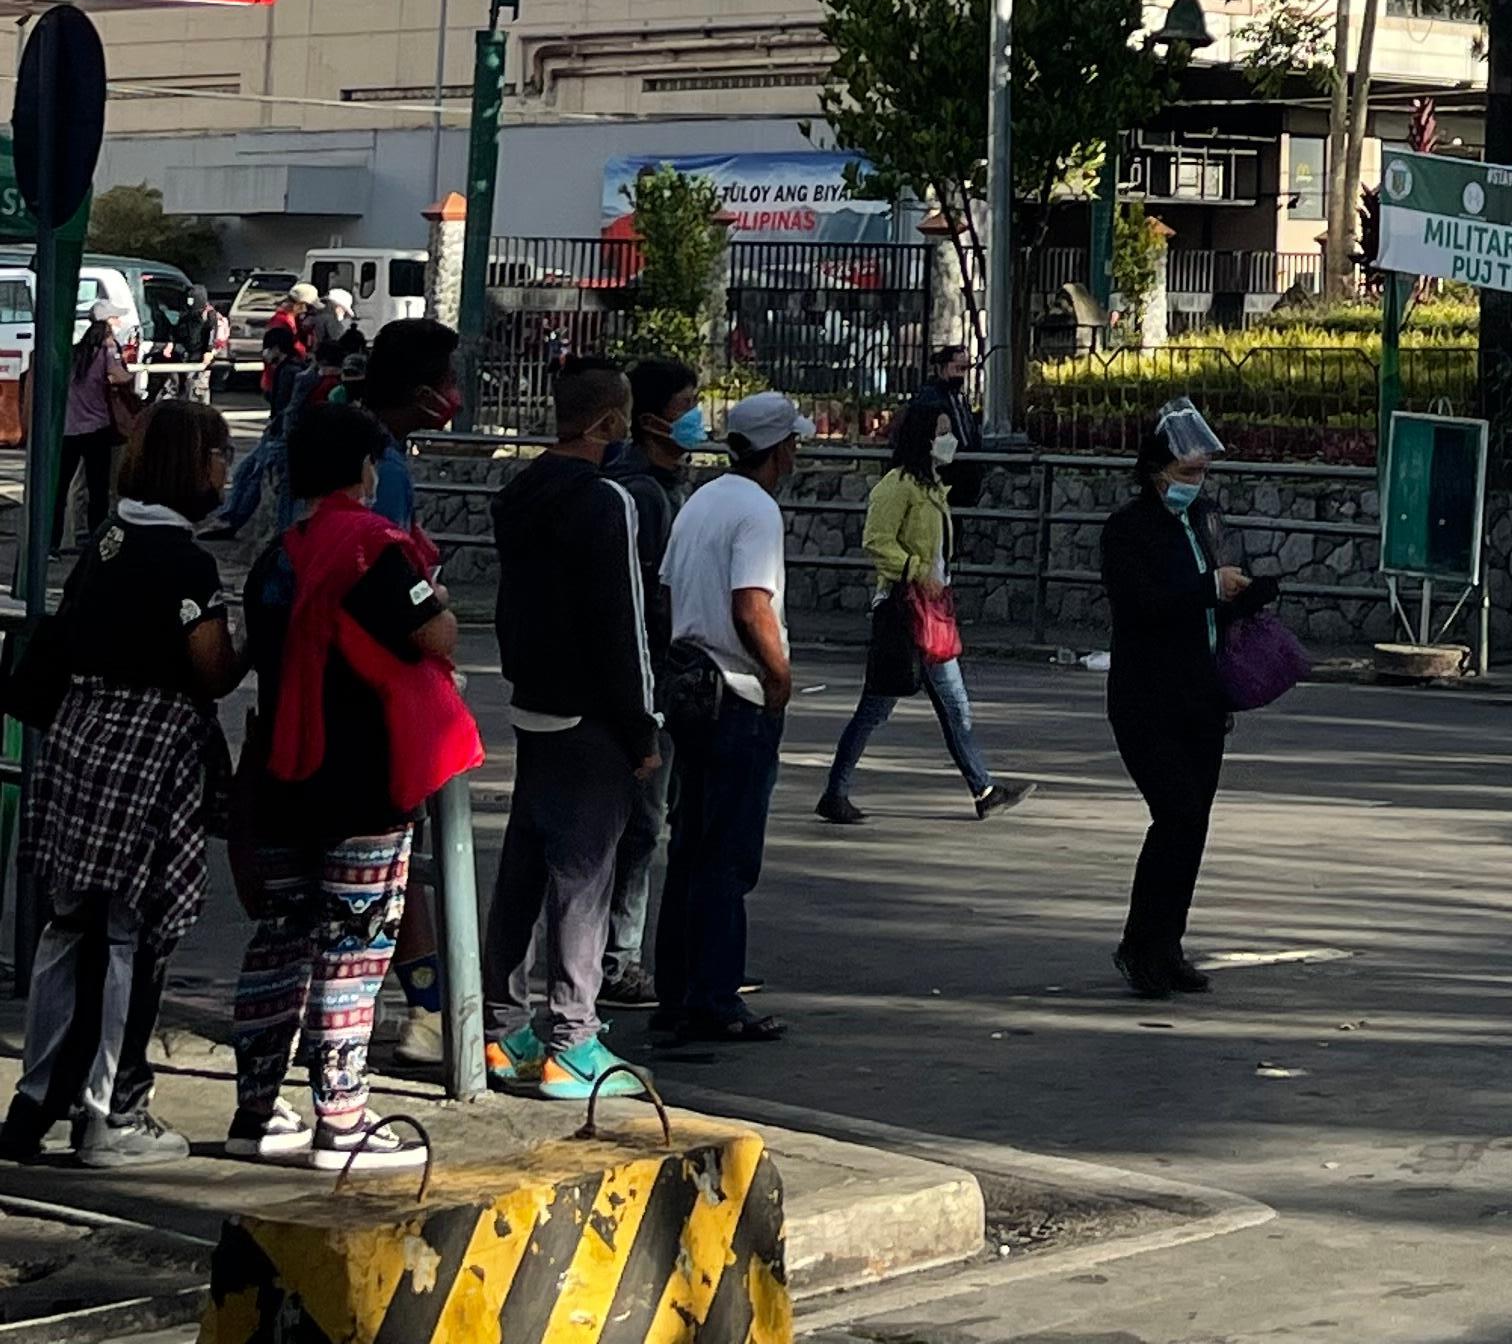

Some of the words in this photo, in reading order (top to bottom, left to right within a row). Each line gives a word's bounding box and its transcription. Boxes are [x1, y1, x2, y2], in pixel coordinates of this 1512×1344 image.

[774, 184, 808, 203] ANG
[813, 184, 853, 203] BIYA
[734, 210, 816, 231] ILIPINAS
[1452, 255, 1493, 285] PUJ
